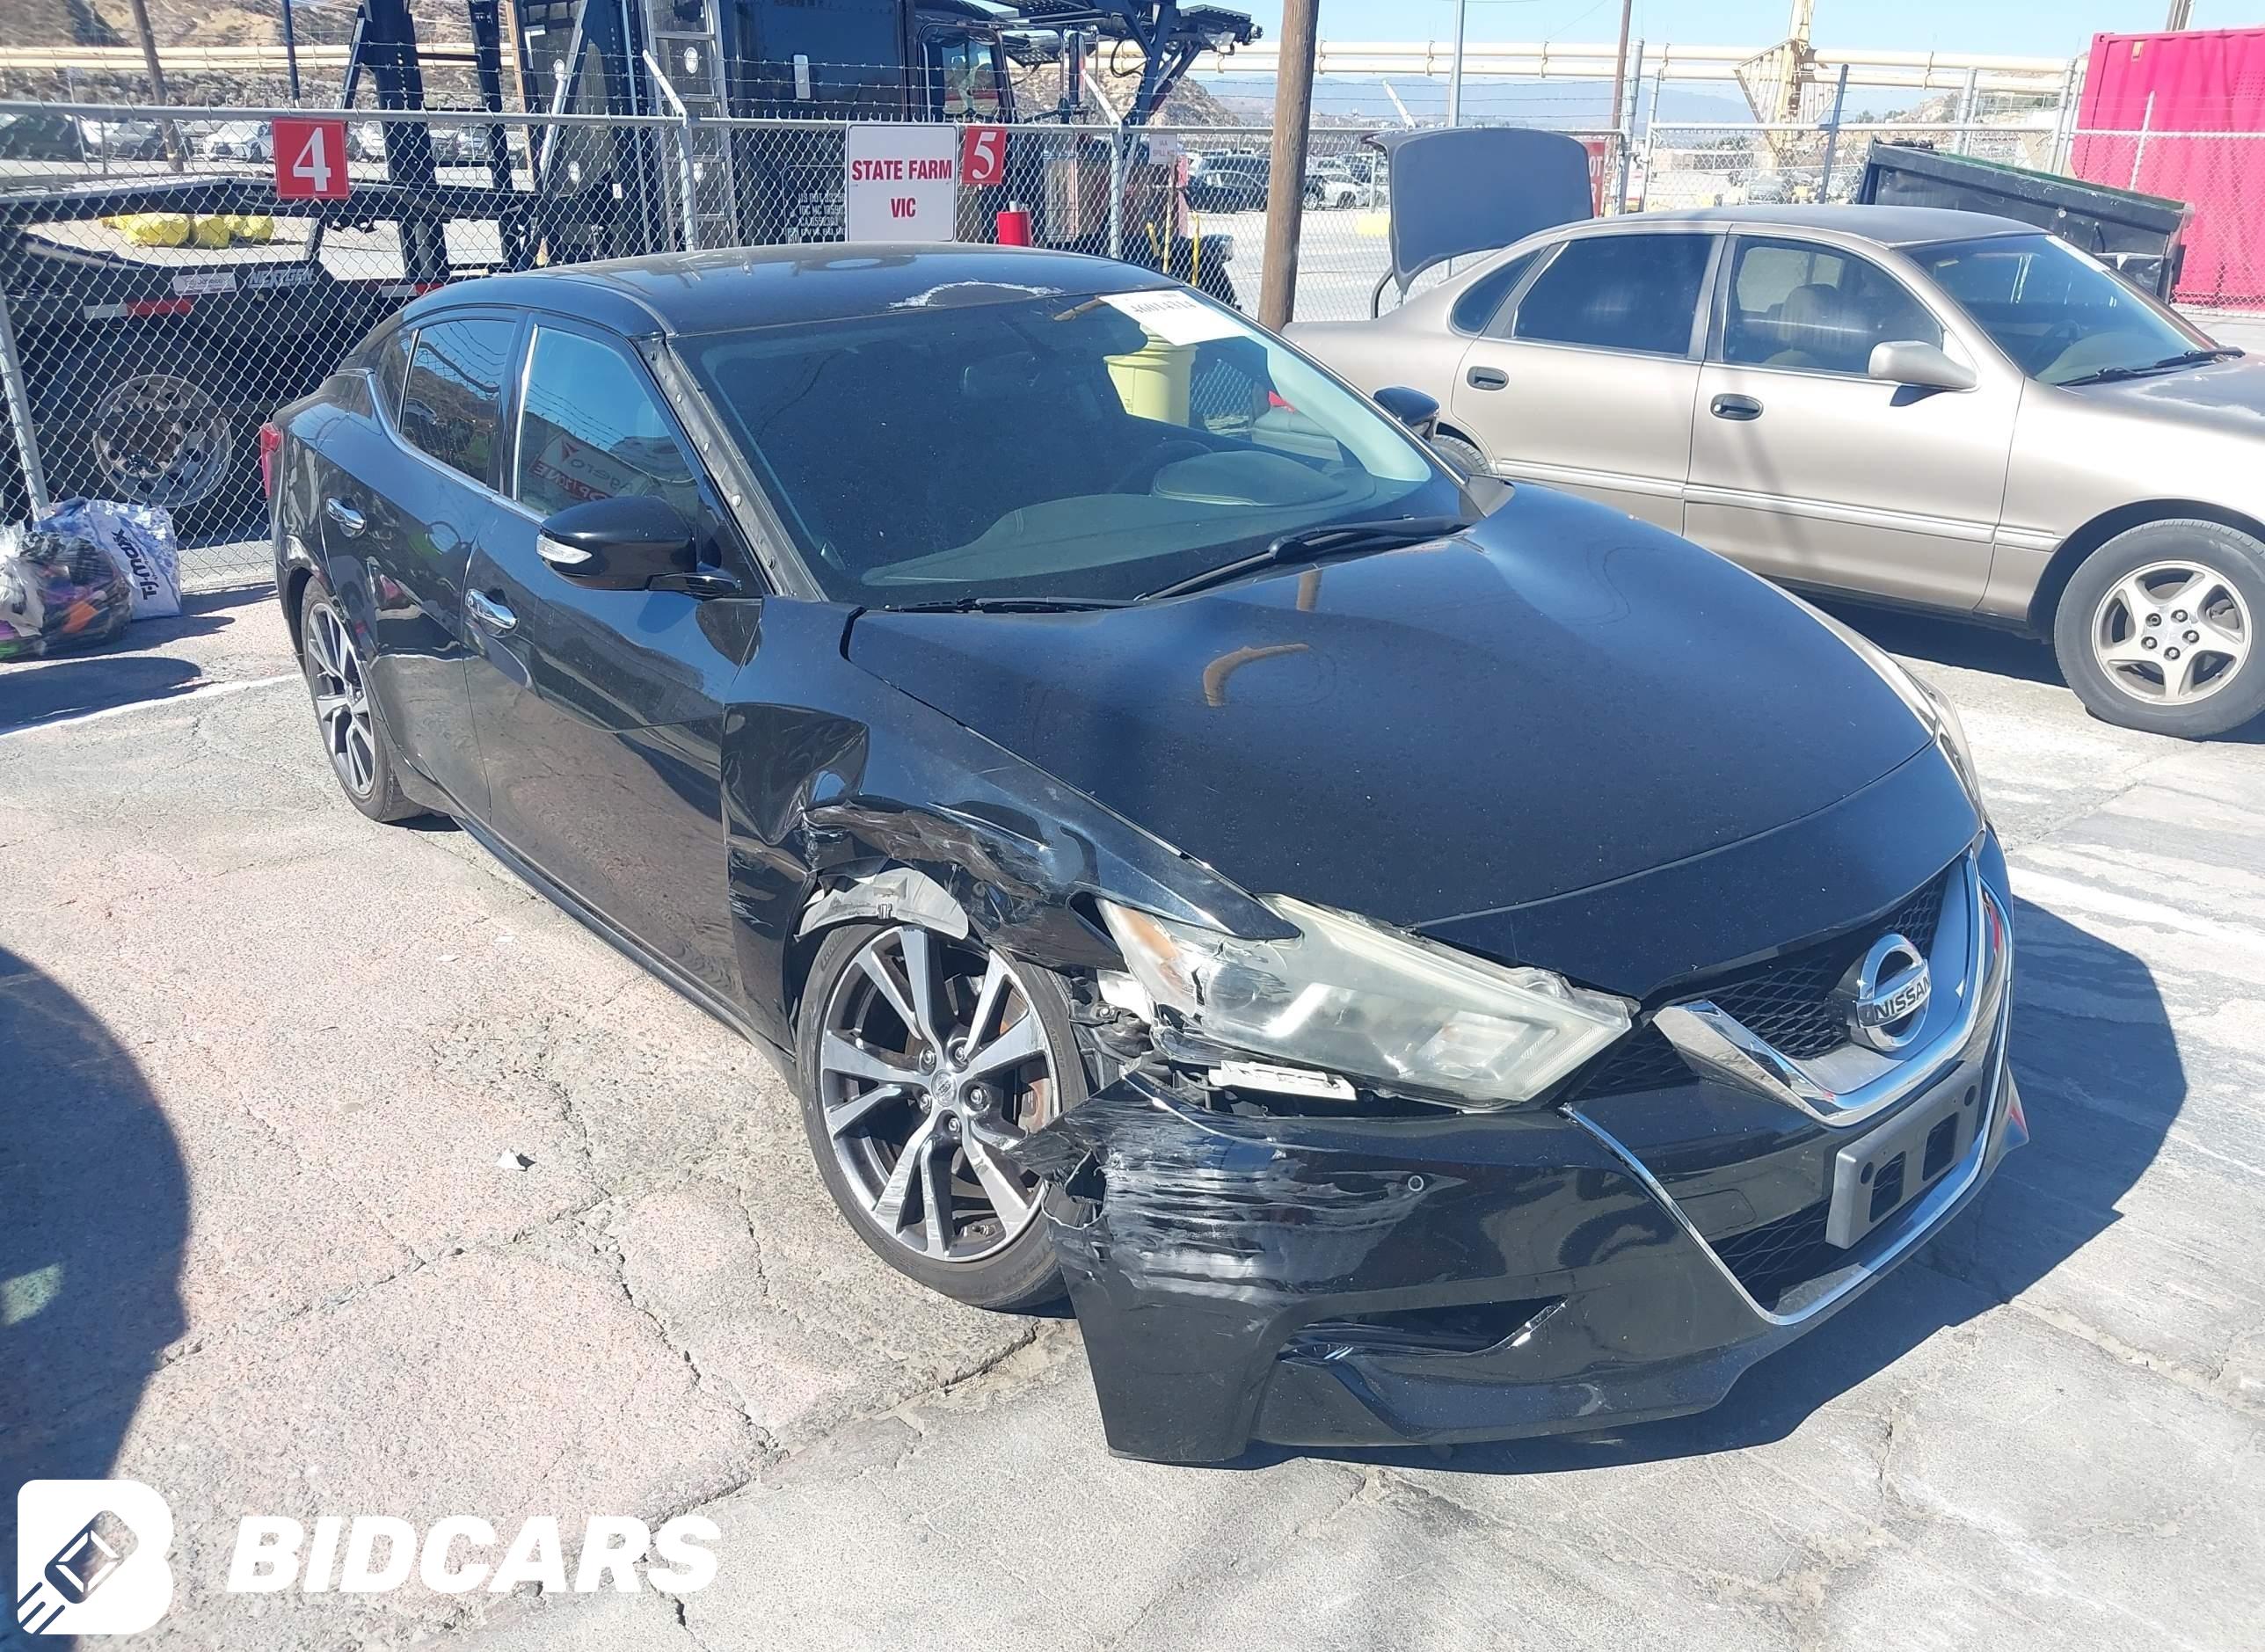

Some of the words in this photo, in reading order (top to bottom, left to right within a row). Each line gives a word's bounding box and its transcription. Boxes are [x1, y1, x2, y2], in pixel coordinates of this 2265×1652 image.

[293, 127, 331, 191] 4
[852, 159, 903, 180] STATE
[908, 159, 952, 179] FARM
[972, 131, 996, 179] 5
[891, 197, 916, 218] VIC
[1874, 973, 1930, 1021] NISSAN
